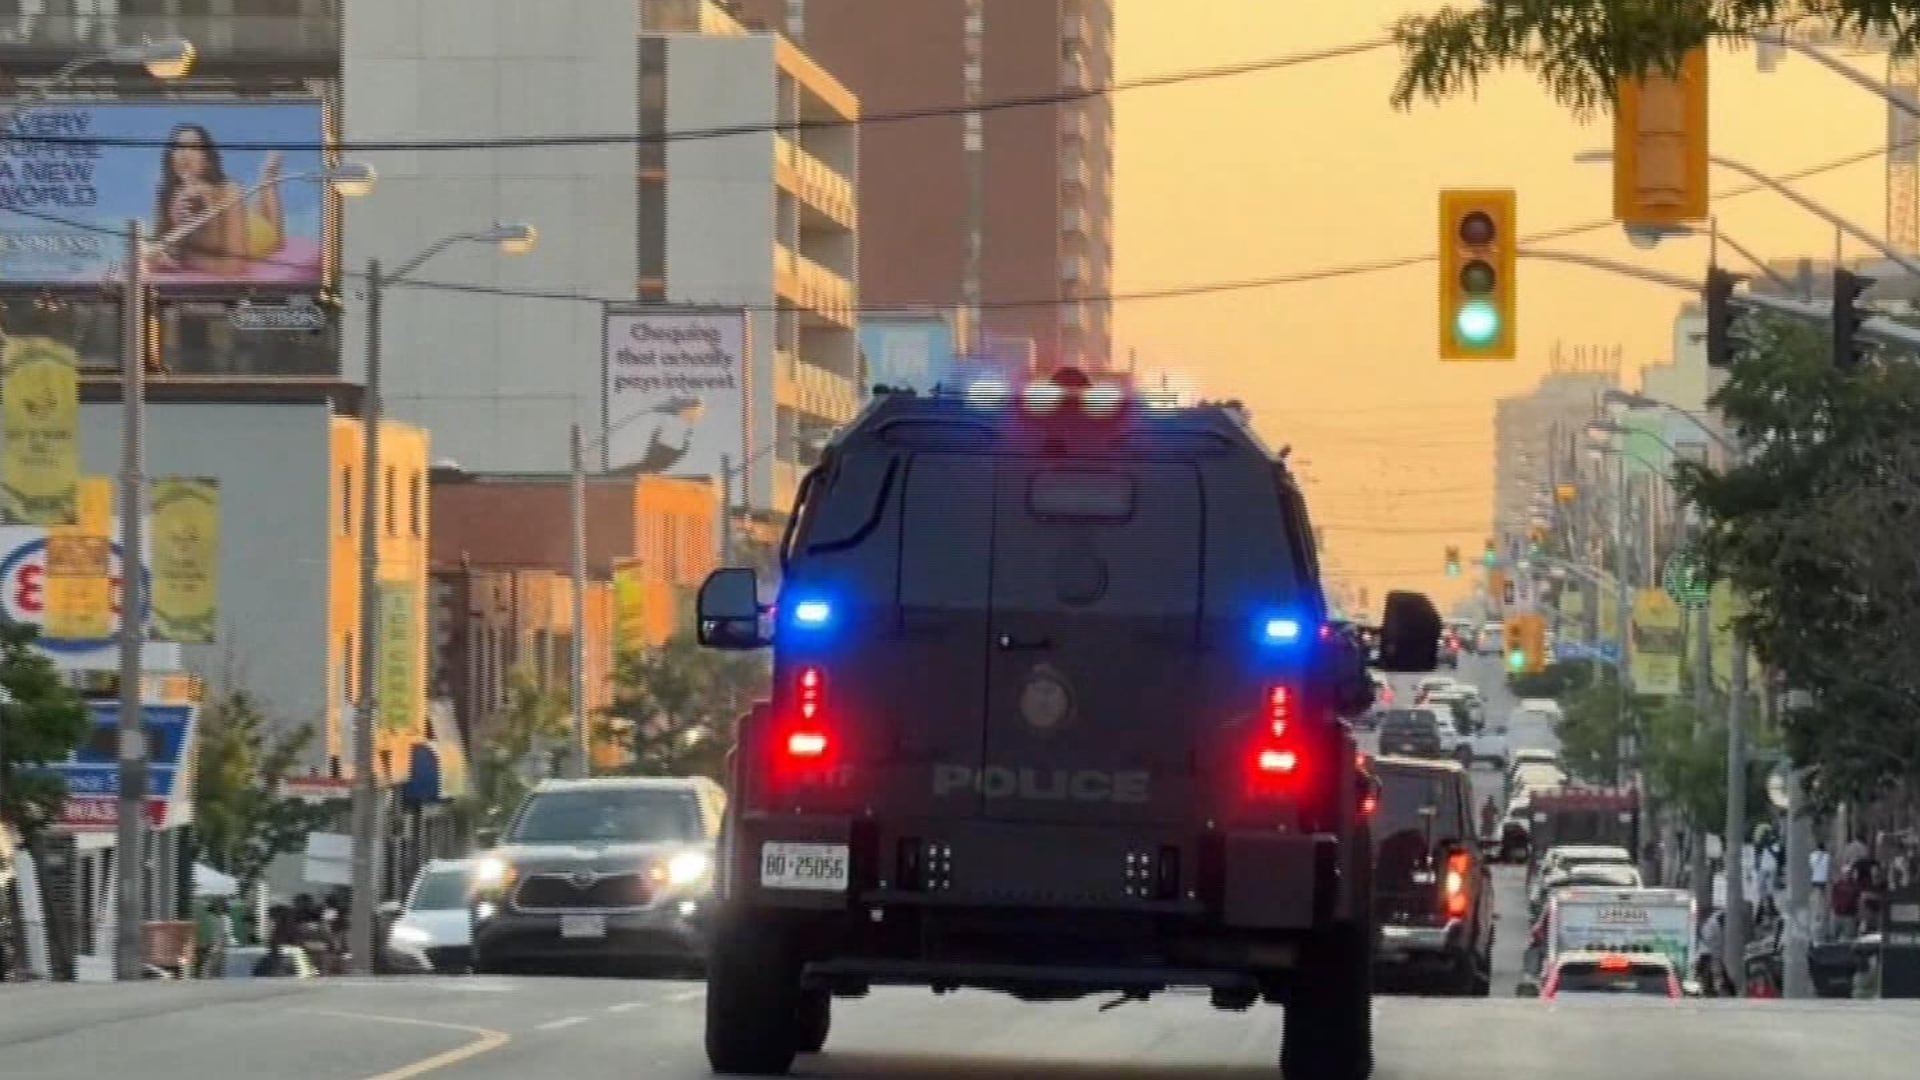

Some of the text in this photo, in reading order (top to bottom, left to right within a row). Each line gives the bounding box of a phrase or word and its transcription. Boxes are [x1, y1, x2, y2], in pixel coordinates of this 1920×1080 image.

[0, 161, 96, 182] A NEW
[631, 321, 722, 346] Chequing
[616, 347, 734, 370] that actually
[615, 373, 736, 394] pays interest
[932, 765, 1152, 804] POLICE
[63, 800, 119, 821] WAS
